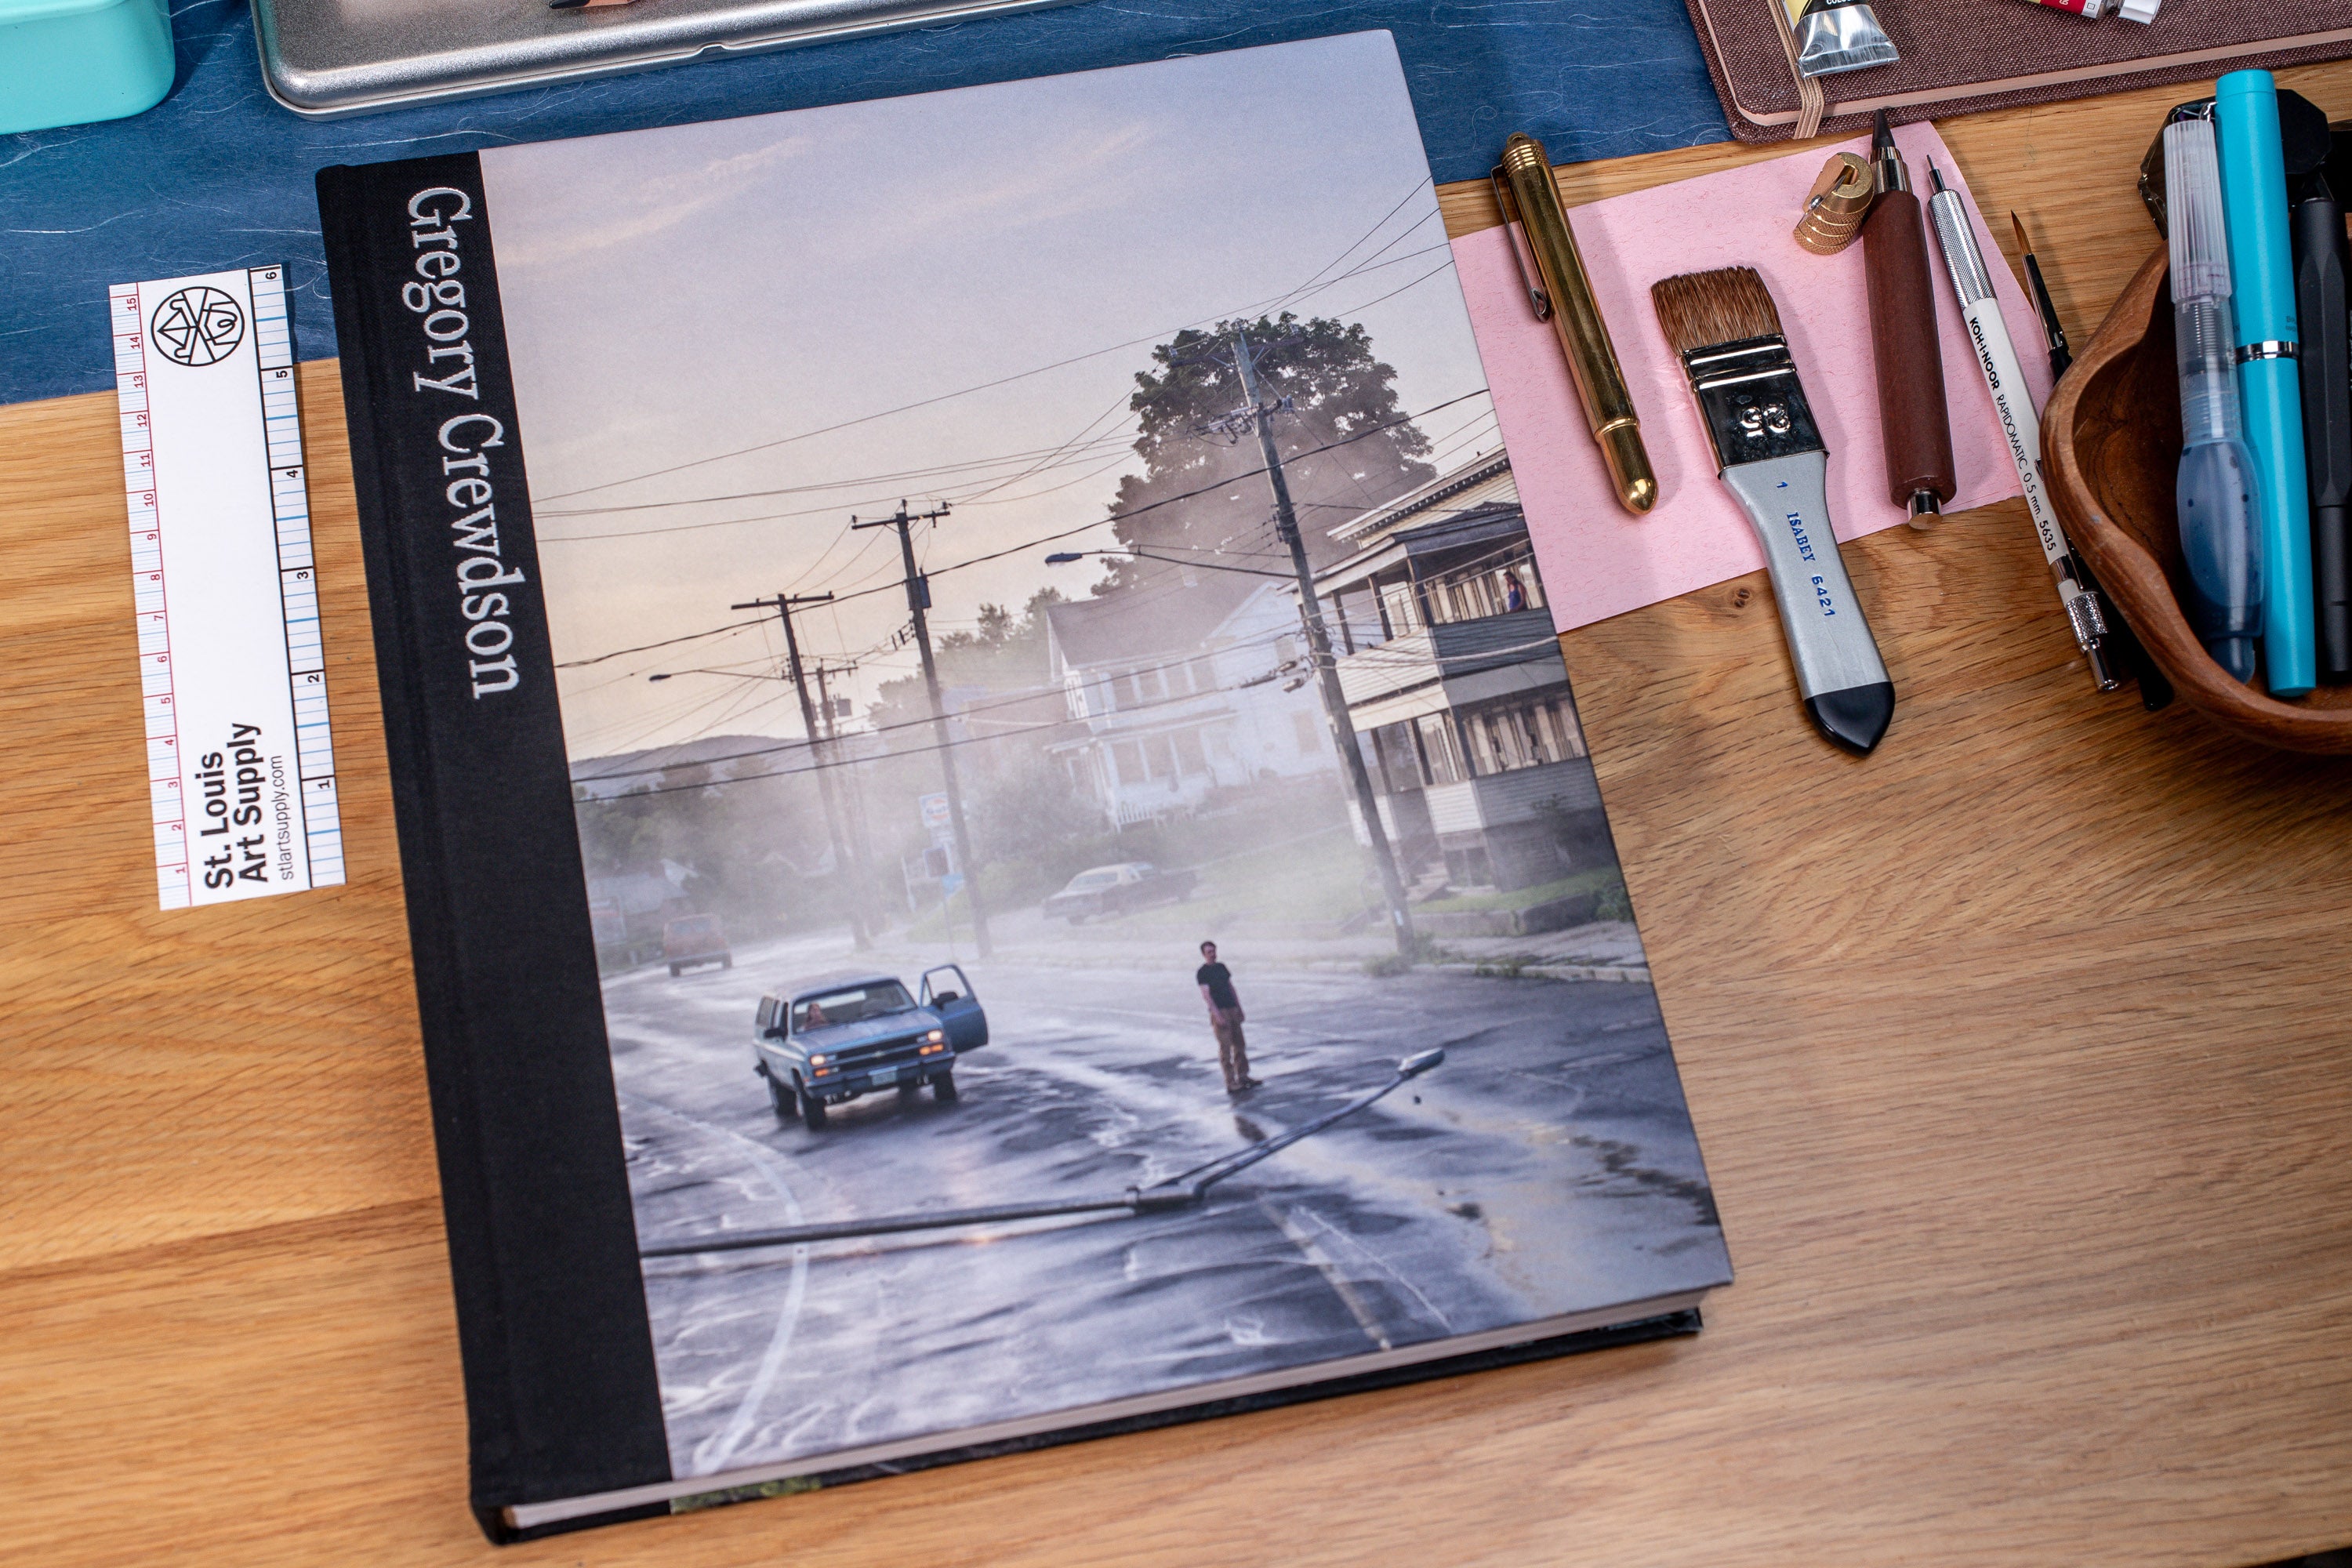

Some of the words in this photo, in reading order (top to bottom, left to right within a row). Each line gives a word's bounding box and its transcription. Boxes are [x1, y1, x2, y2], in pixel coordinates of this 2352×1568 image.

[266, 271, 278, 280] 6
[402, 187, 479, 400] Gregory
[126, 297, 136, 311] 15
[130, 336, 140, 350] 14
[133, 375, 143, 388] 13
[136, 413, 147, 427] 12
[1969, 317, 2000, 390] KOH-I-NOOR
[1996, 394, 2028, 470] RAPIDOMATIC
[2023, 473, 2037, 493] 0.5
[2039, 520, 2056, 551] 5635
[140, 453, 151, 466] 11
[144, 492, 154, 506] 10
[438, 414, 526, 699] Crewdson
[1787, 511, 1816, 561] ISABEY
[1811, 575, 1836, 616] 6421
[297, 571, 309, 579] 3
[307, 674, 320, 683] 2
[227, 723, 265, 826] Supply
[318, 780, 330, 789] 1
[195, 752, 229, 837] Louis
[270, 755, 294, 880] stlartsupply.com
[238, 833, 268, 882] Art
[205, 844, 234, 888] St.
